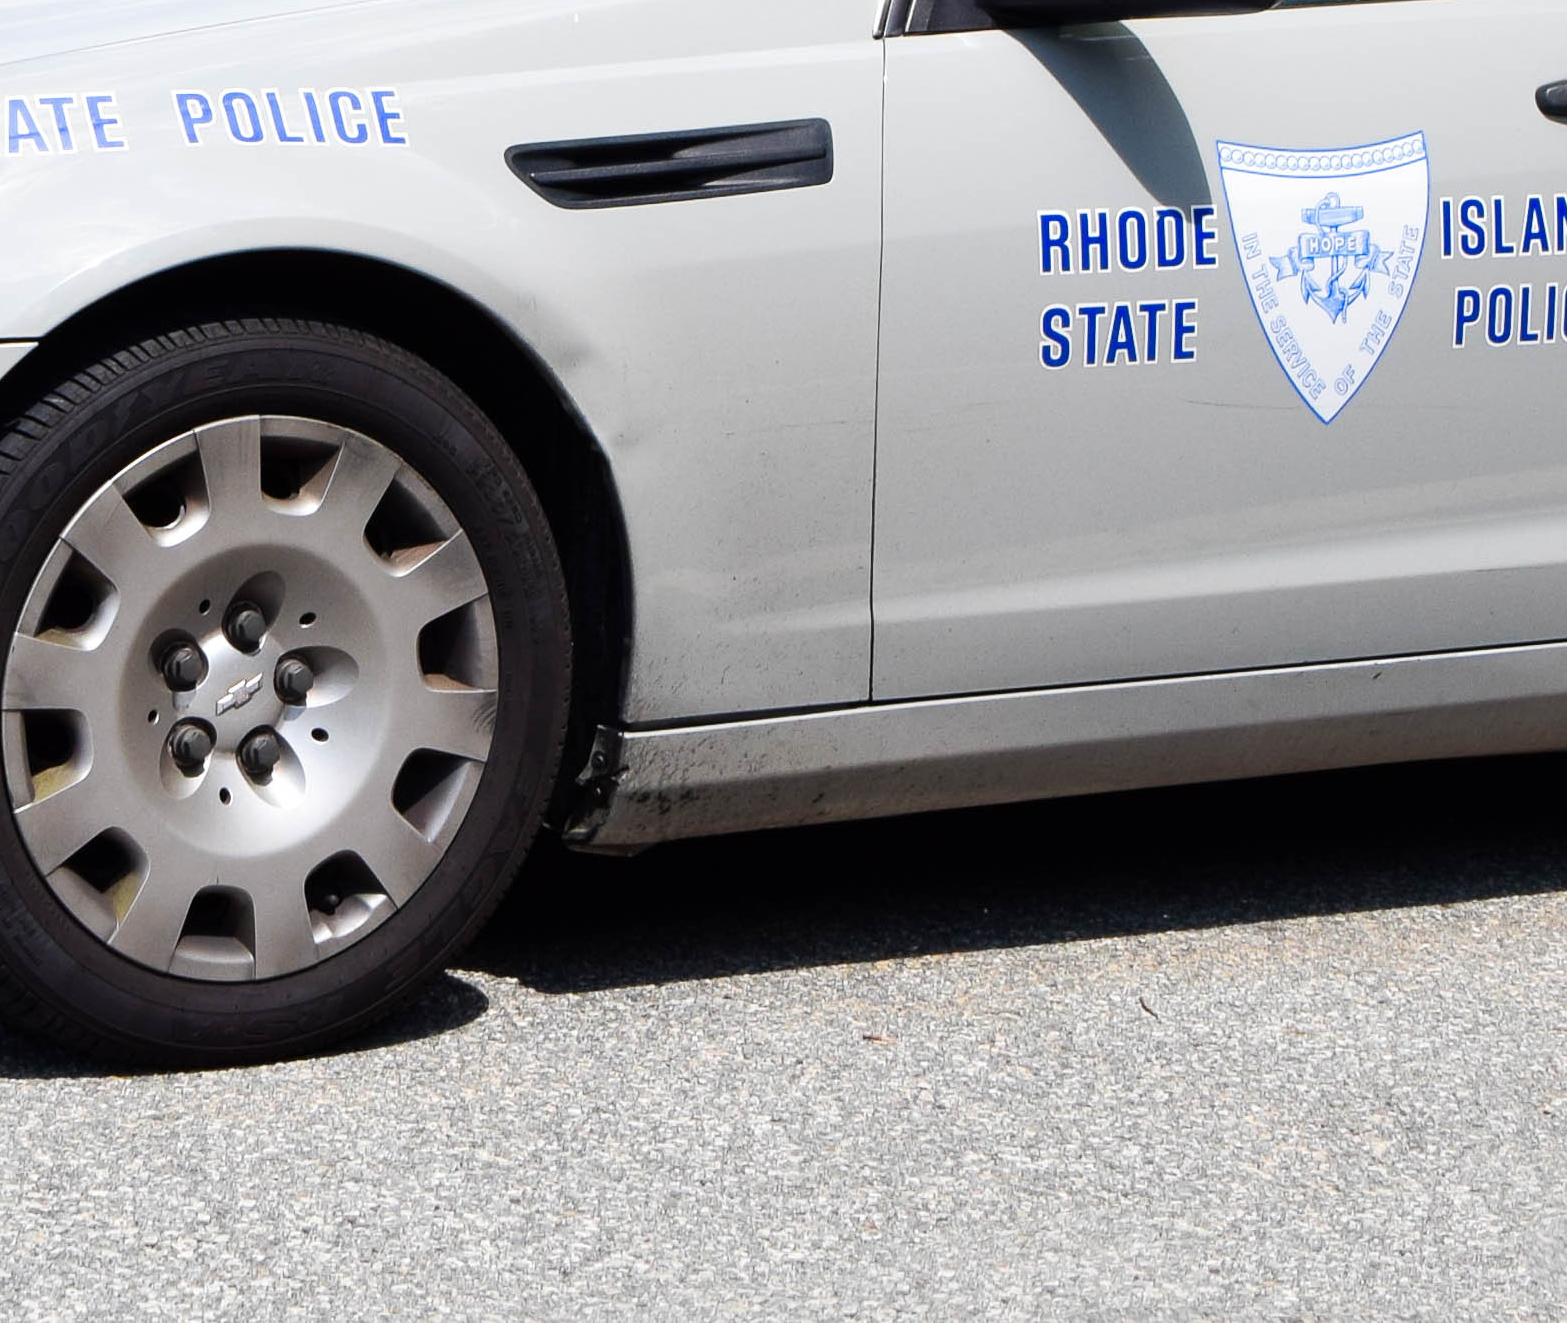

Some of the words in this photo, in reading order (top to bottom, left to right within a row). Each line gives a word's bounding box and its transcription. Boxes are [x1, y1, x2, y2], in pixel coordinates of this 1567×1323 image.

[174, 89, 409, 148] POLICE
[1039, 205, 1218, 275] RHODE
[1308, 236, 1358, 254] HOPE
[1040, 300, 1198, 369] STATE
[1241, 232, 1262, 260] IN
[1252, 266, 1279, 314] THE
[1270, 316, 1326, 400] SERVICE
[1334, 364, 1357, 396] OF
[1359, 310, 1392, 356] THE
[1387, 224, 1420, 298] STATE
